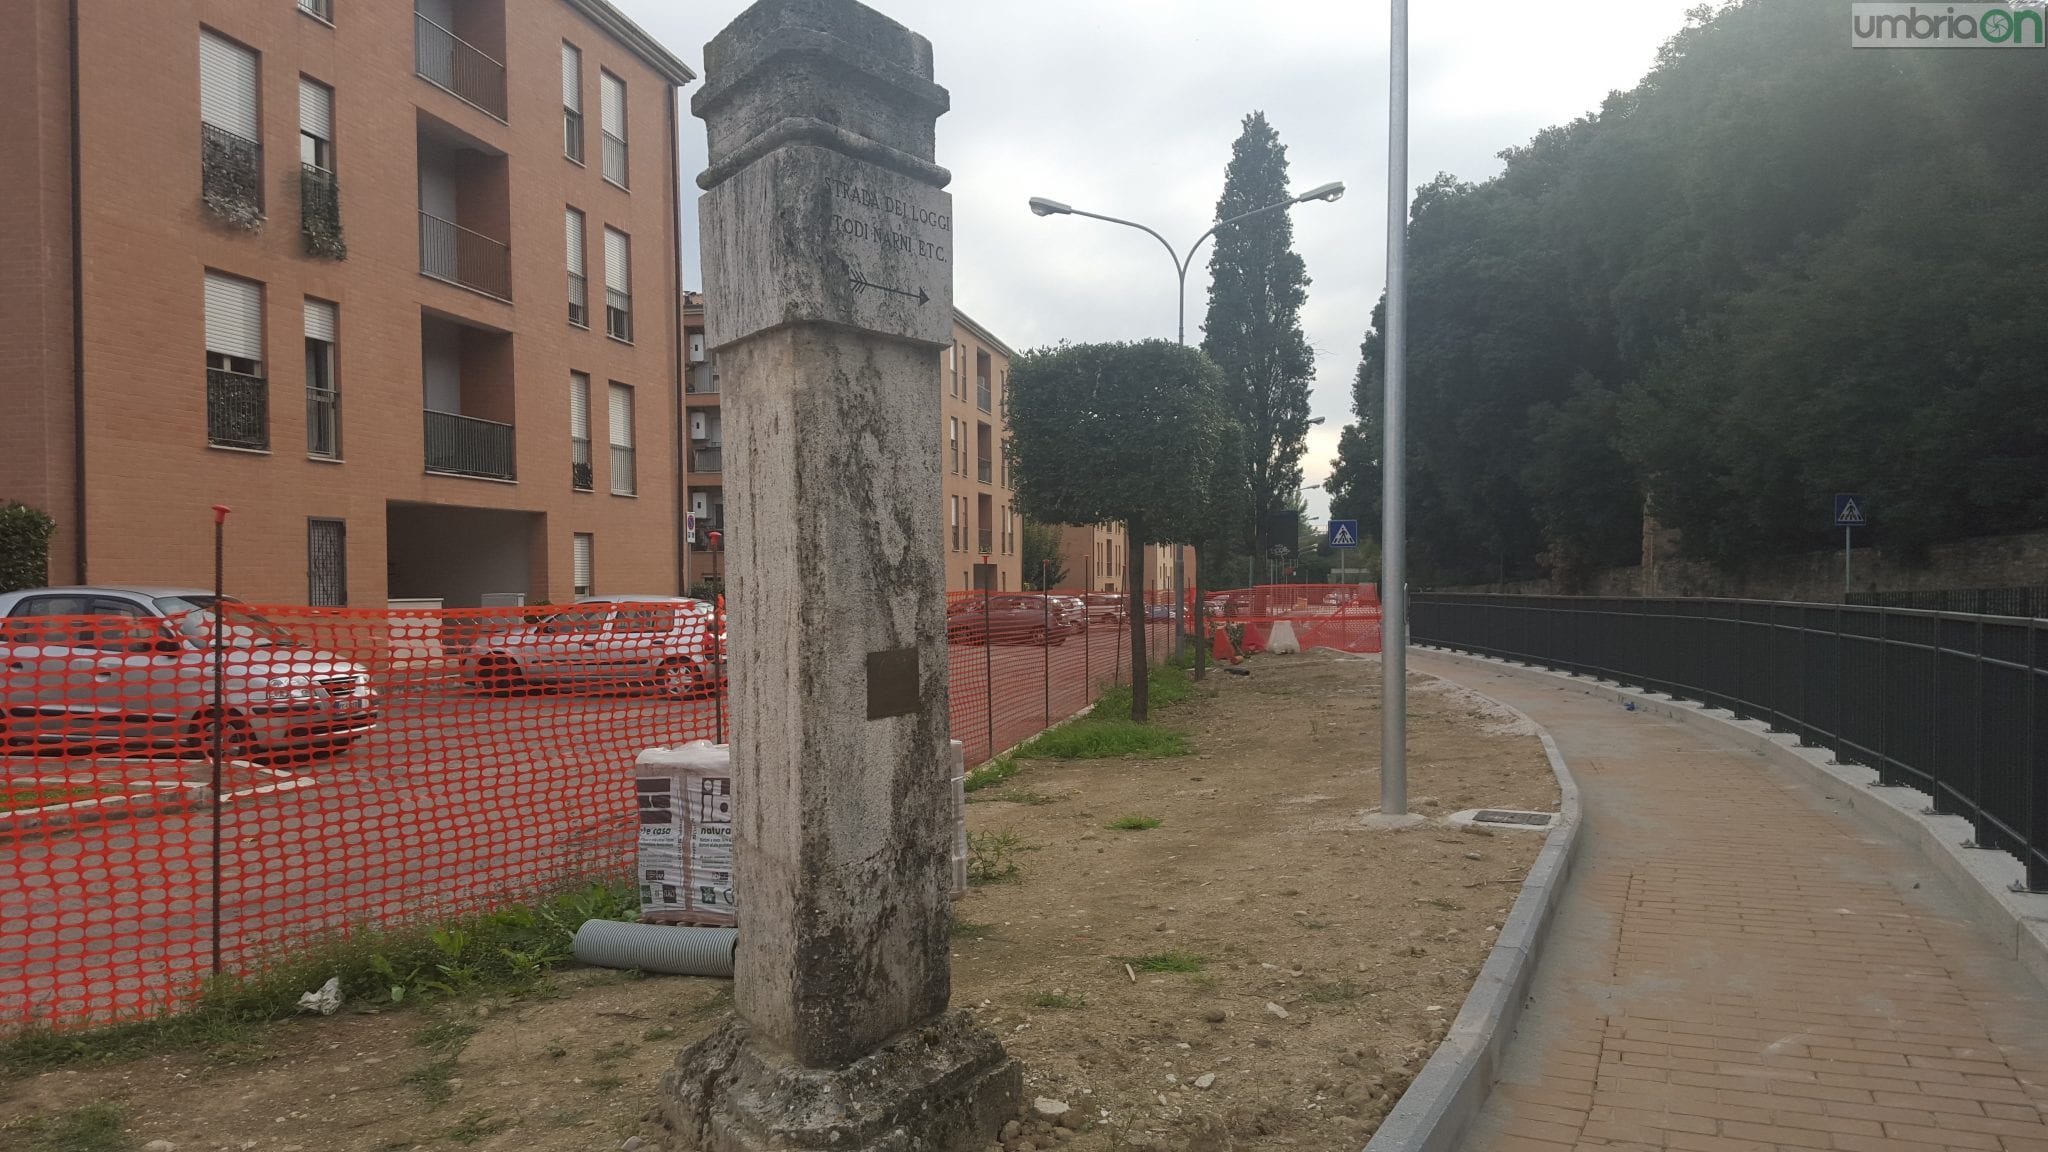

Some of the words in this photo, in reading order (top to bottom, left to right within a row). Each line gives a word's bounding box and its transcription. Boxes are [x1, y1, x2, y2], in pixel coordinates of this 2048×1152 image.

[824, 176, 881, 210] STRADA
[885, 196, 907, 218] DEI
[912, 205, 951, 232] LOGGI
[833, 214, 869, 240] TODI
[873, 226, 912, 253] NARNI
[918, 239, 948, 263] ETC.
